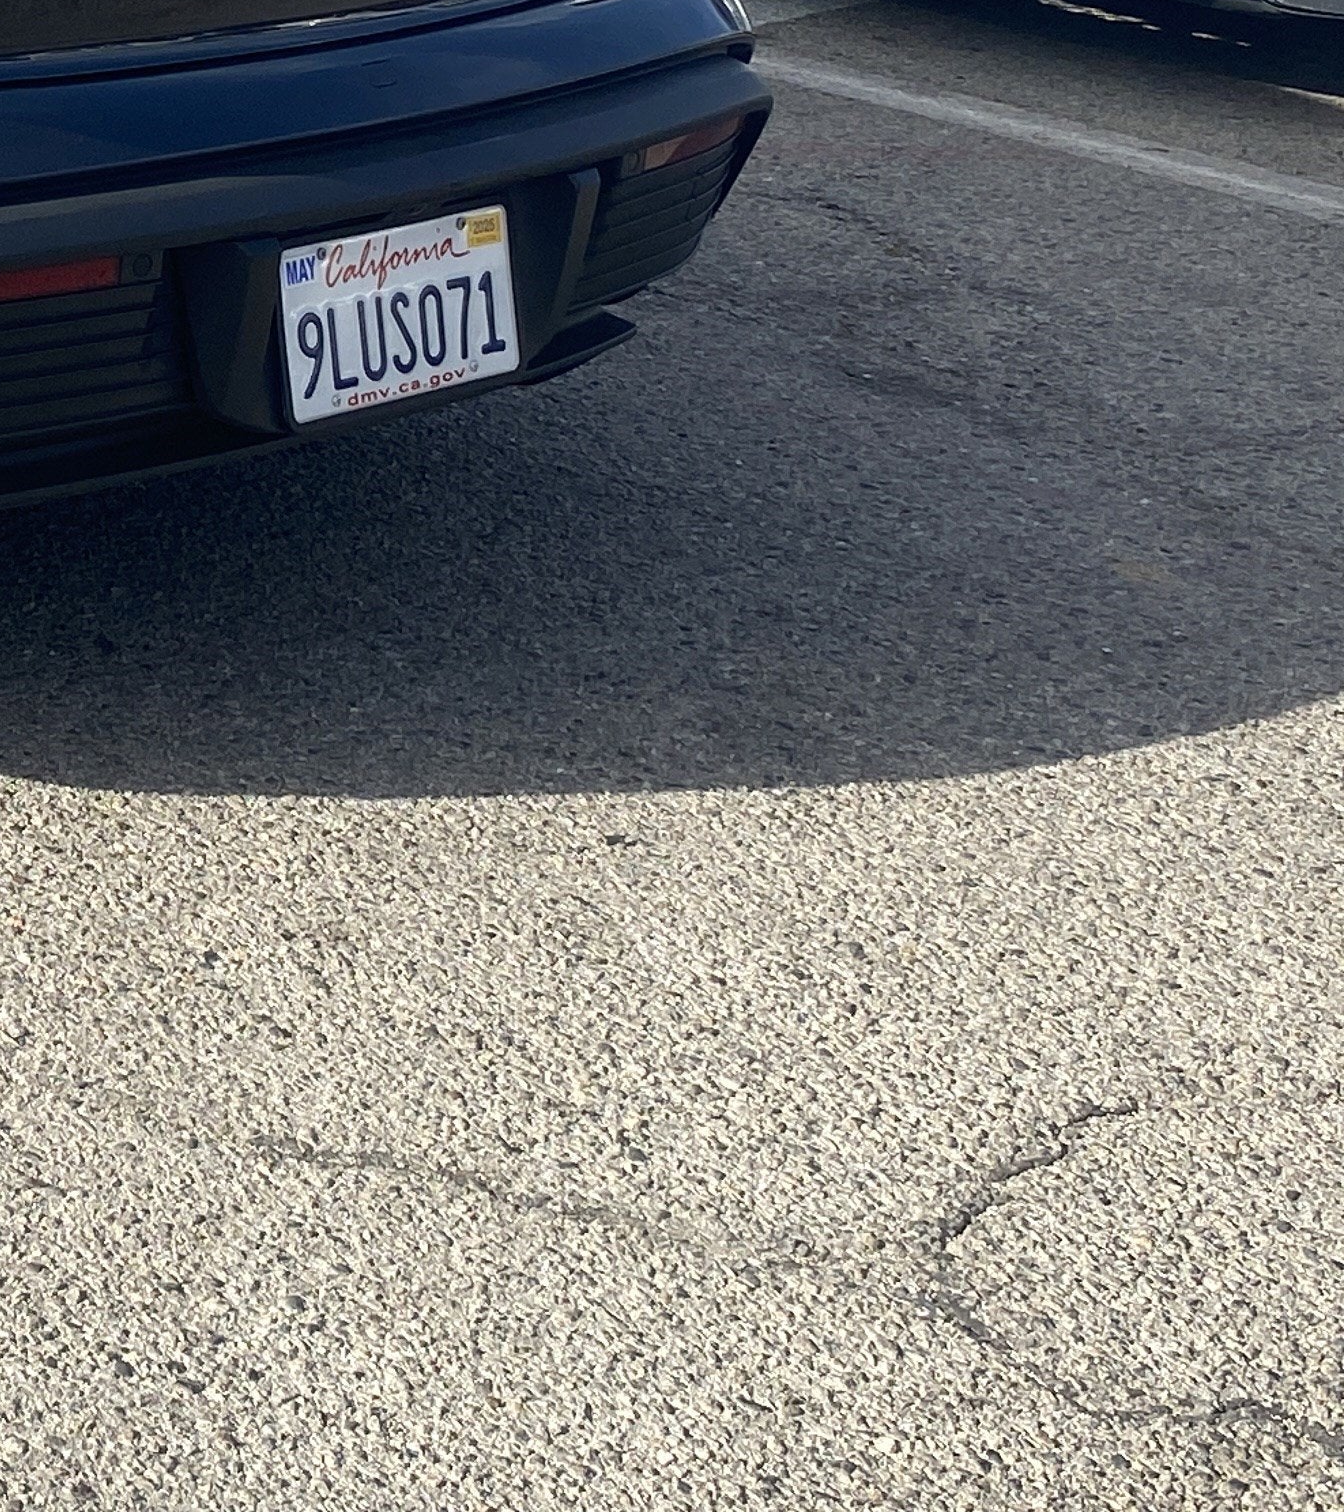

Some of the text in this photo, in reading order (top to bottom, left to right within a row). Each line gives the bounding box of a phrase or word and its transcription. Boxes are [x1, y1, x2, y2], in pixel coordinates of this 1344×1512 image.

[286, 236, 469, 290] MAY California
[297, 270, 506, 399] 9LUS071
[348, 367, 466, 406] dmv.ca.gov
